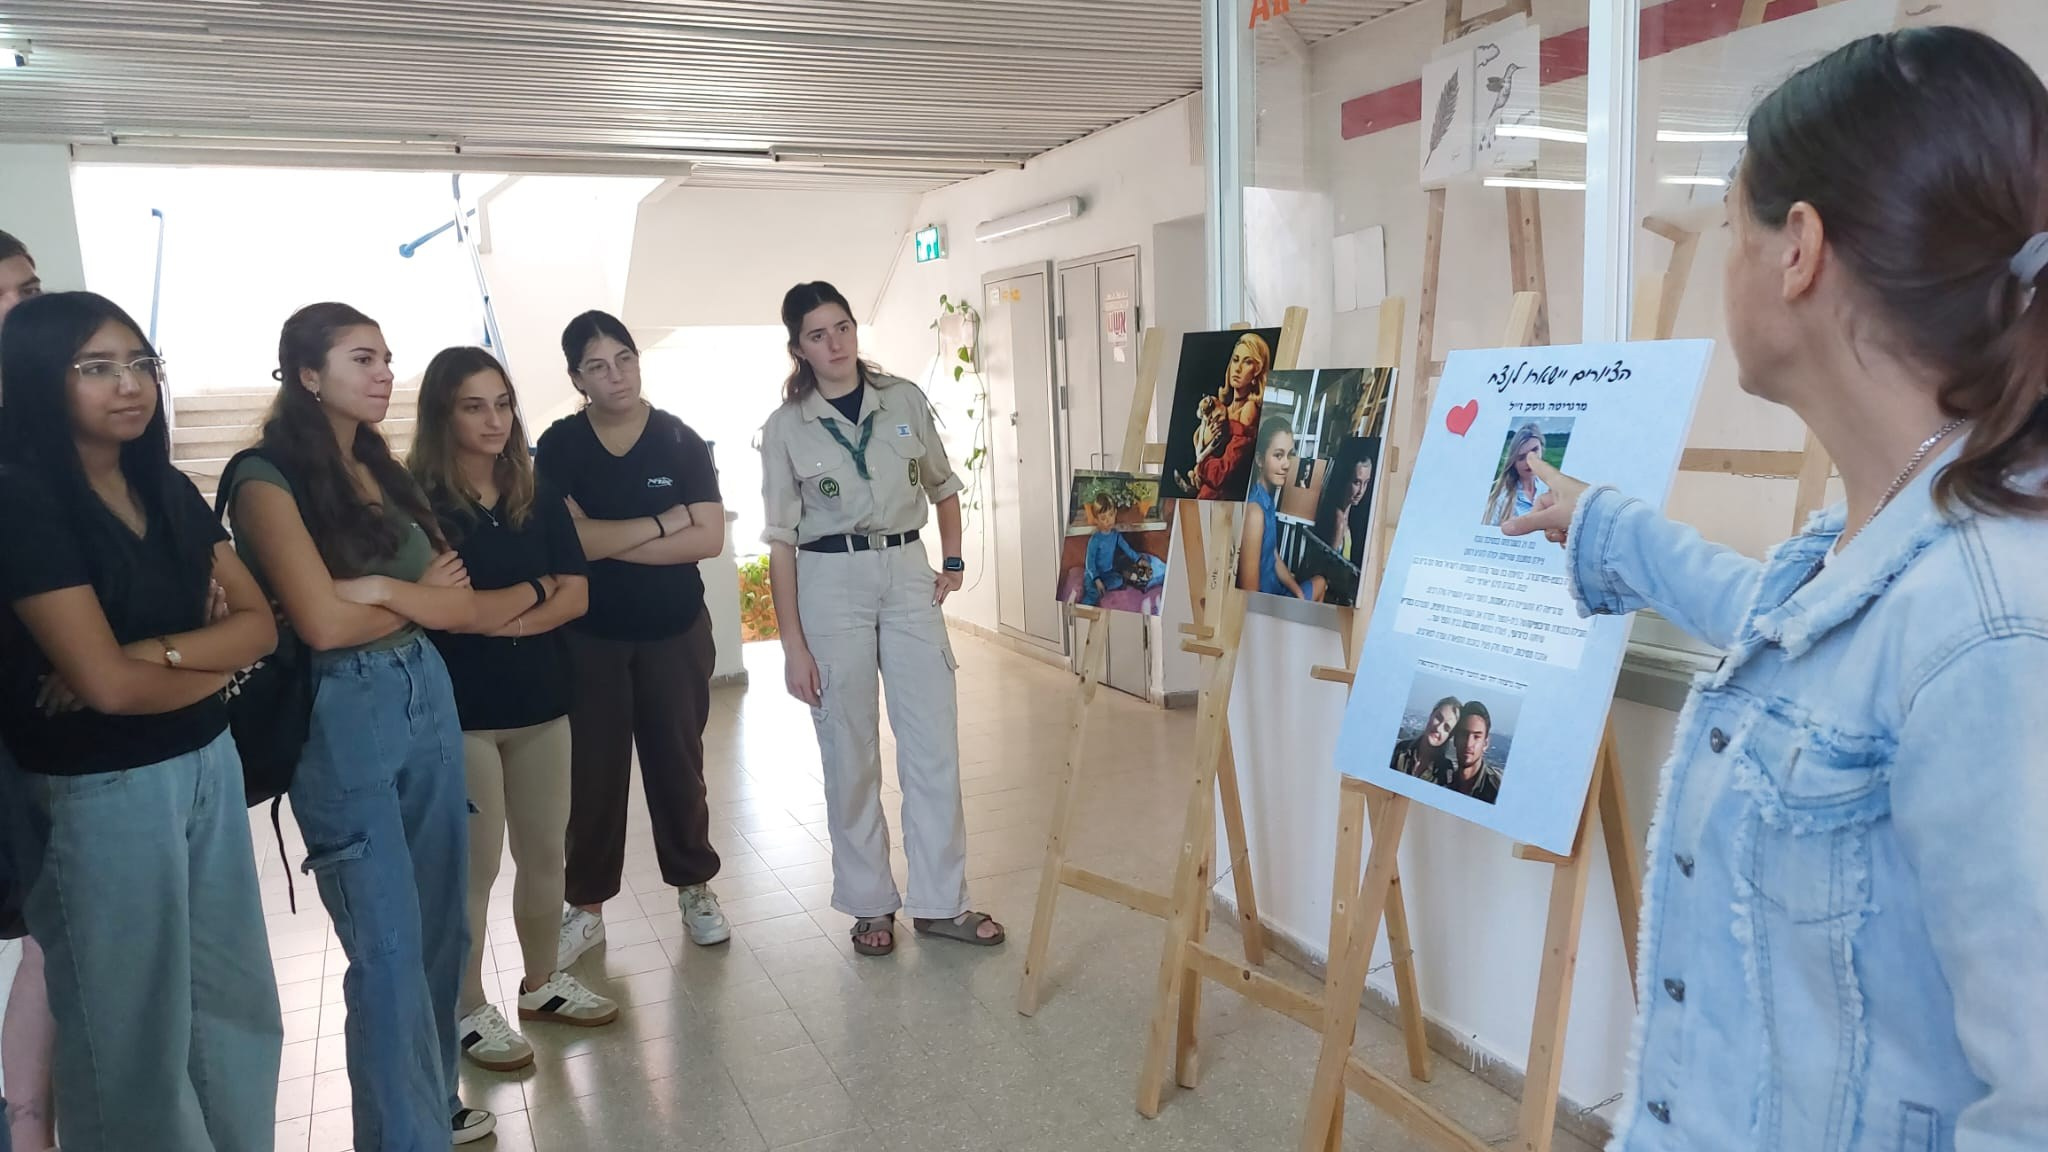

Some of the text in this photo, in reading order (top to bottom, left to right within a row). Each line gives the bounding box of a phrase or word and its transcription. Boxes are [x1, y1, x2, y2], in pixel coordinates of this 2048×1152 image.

[1487, 360, 1632, 393] הציורים יישארו לנצח
